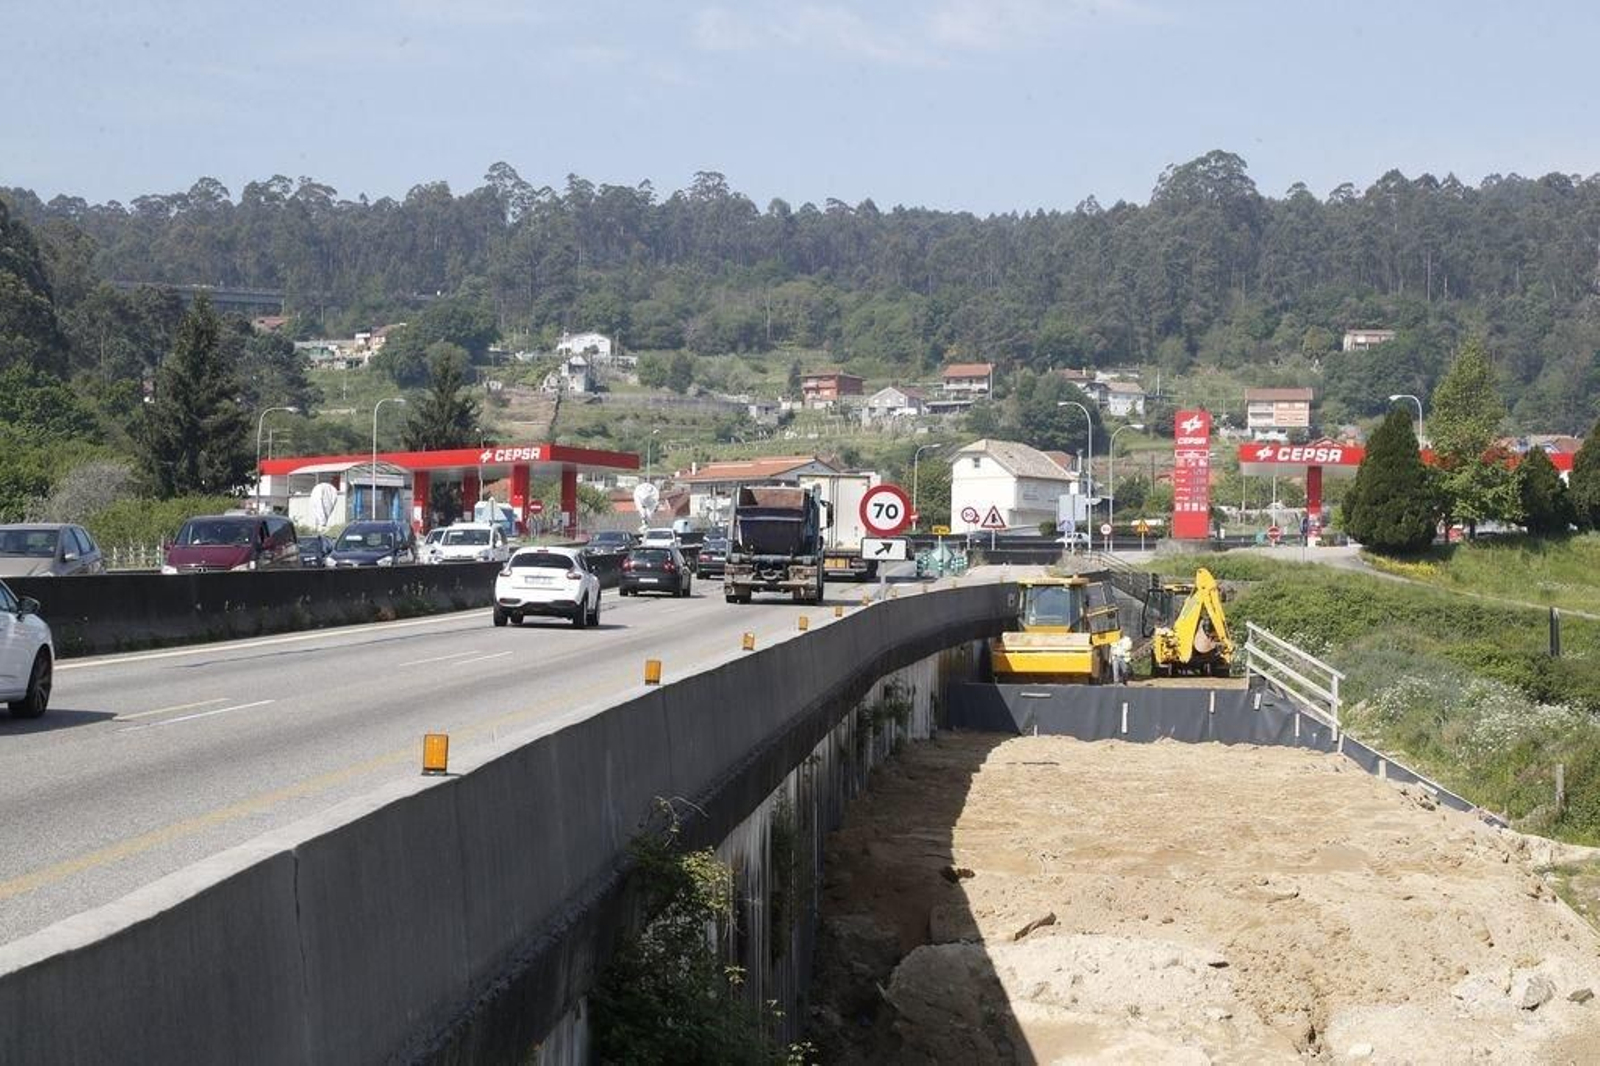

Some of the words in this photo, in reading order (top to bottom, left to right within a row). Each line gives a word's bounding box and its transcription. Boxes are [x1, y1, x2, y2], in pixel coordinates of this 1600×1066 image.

[495, 447, 541, 461] CEPSA
[1277, 447, 1342, 462] CEPSA
[873, 503, 898, 519] 70
